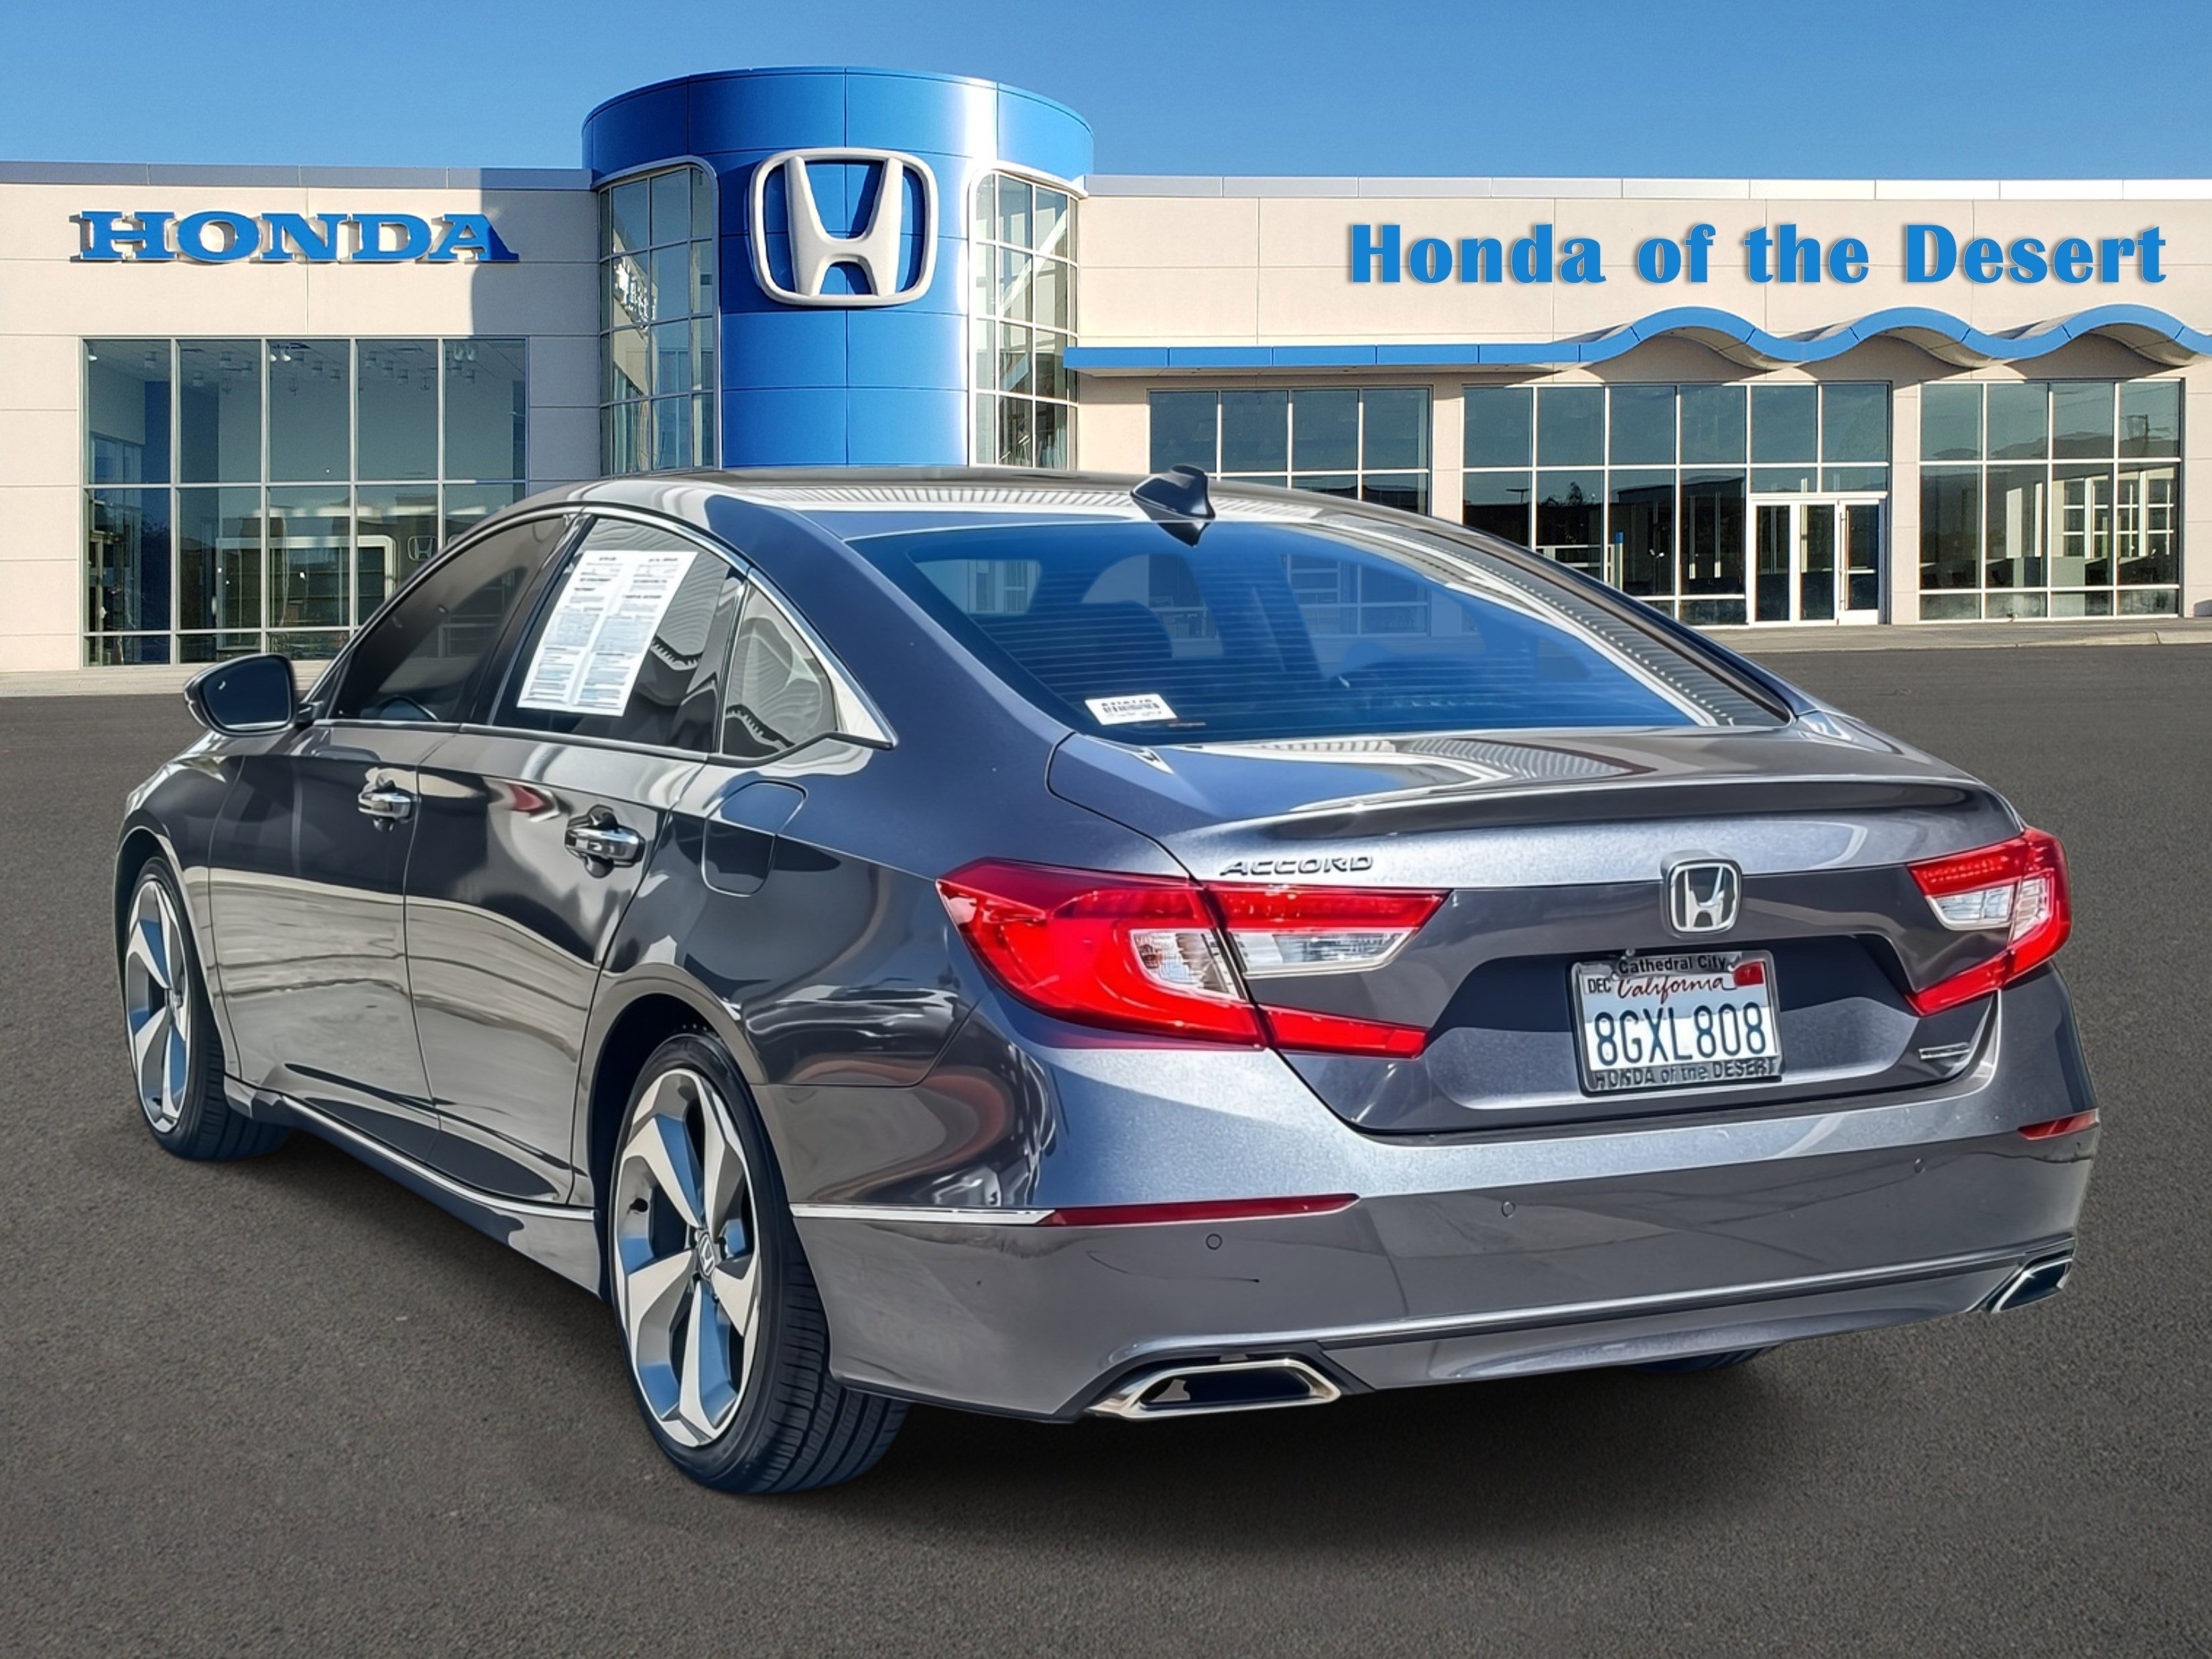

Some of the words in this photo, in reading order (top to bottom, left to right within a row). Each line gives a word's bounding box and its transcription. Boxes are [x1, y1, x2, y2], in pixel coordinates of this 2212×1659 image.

[79, 210, 519, 263] HONDA
[1351, 223, 1607, 284] Honda
[1638, 223, 1717, 284] of
[1743, 223, 1869, 284] the
[1906, 224, 2167, 284] Desert
[1219, 856, 1374, 877] ACCORD
[1618, 957, 1693, 974] Cathedral
[1697, 955, 1727, 969] City
[1587, 977, 1611, 993] DEC
[1617, 976, 1737, 1004] California
[1594, 1002, 1766, 1066] 8GXL808
[1595, 1067, 1656, 1090] HONDA
[1713, 1056, 1778, 1078] DESERT
